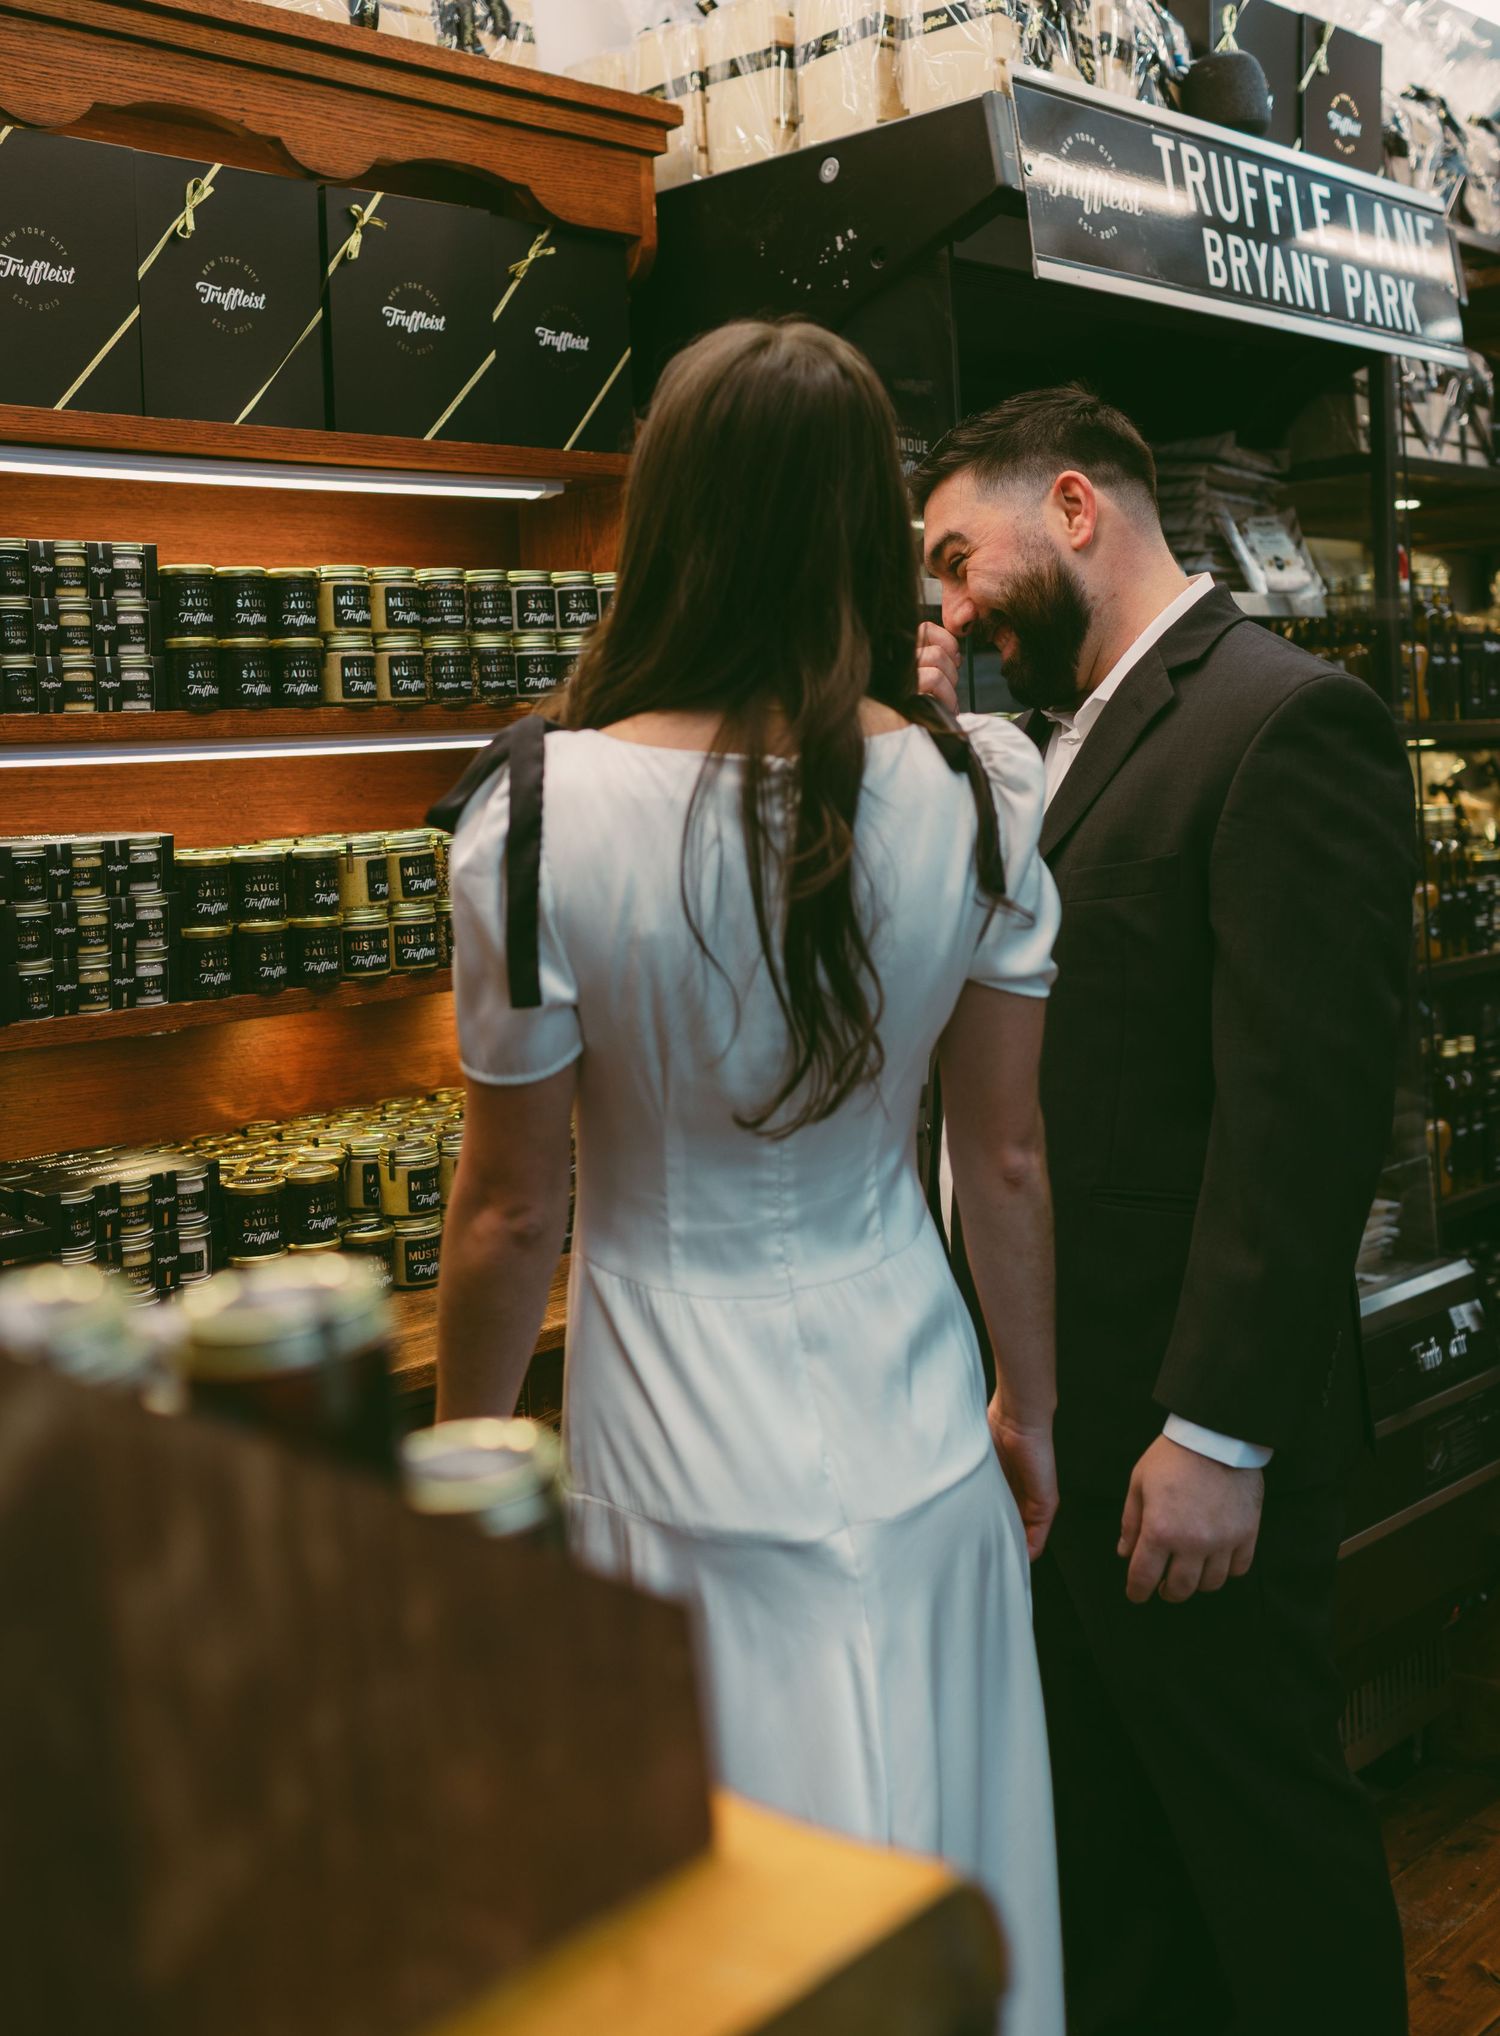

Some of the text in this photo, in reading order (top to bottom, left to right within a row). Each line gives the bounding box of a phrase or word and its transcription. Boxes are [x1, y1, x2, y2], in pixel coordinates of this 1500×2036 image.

[1151, 134, 1435, 272] TRUFFLE LANE
[0, 253, 76, 286] Truffleist
[1202, 227, 1422, 335] BRYANT PARK
[195, 281, 266, 311] Truffleist
[382, 305, 446, 334] Truffleist
[534, 326, 590, 353] Truffleist
[337, 595, 365, 606] MUST
[344, 667, 370, 677] MUST
[392, 665, 419, 676] MUST
[245, 882, 279, 892] SAUCE
